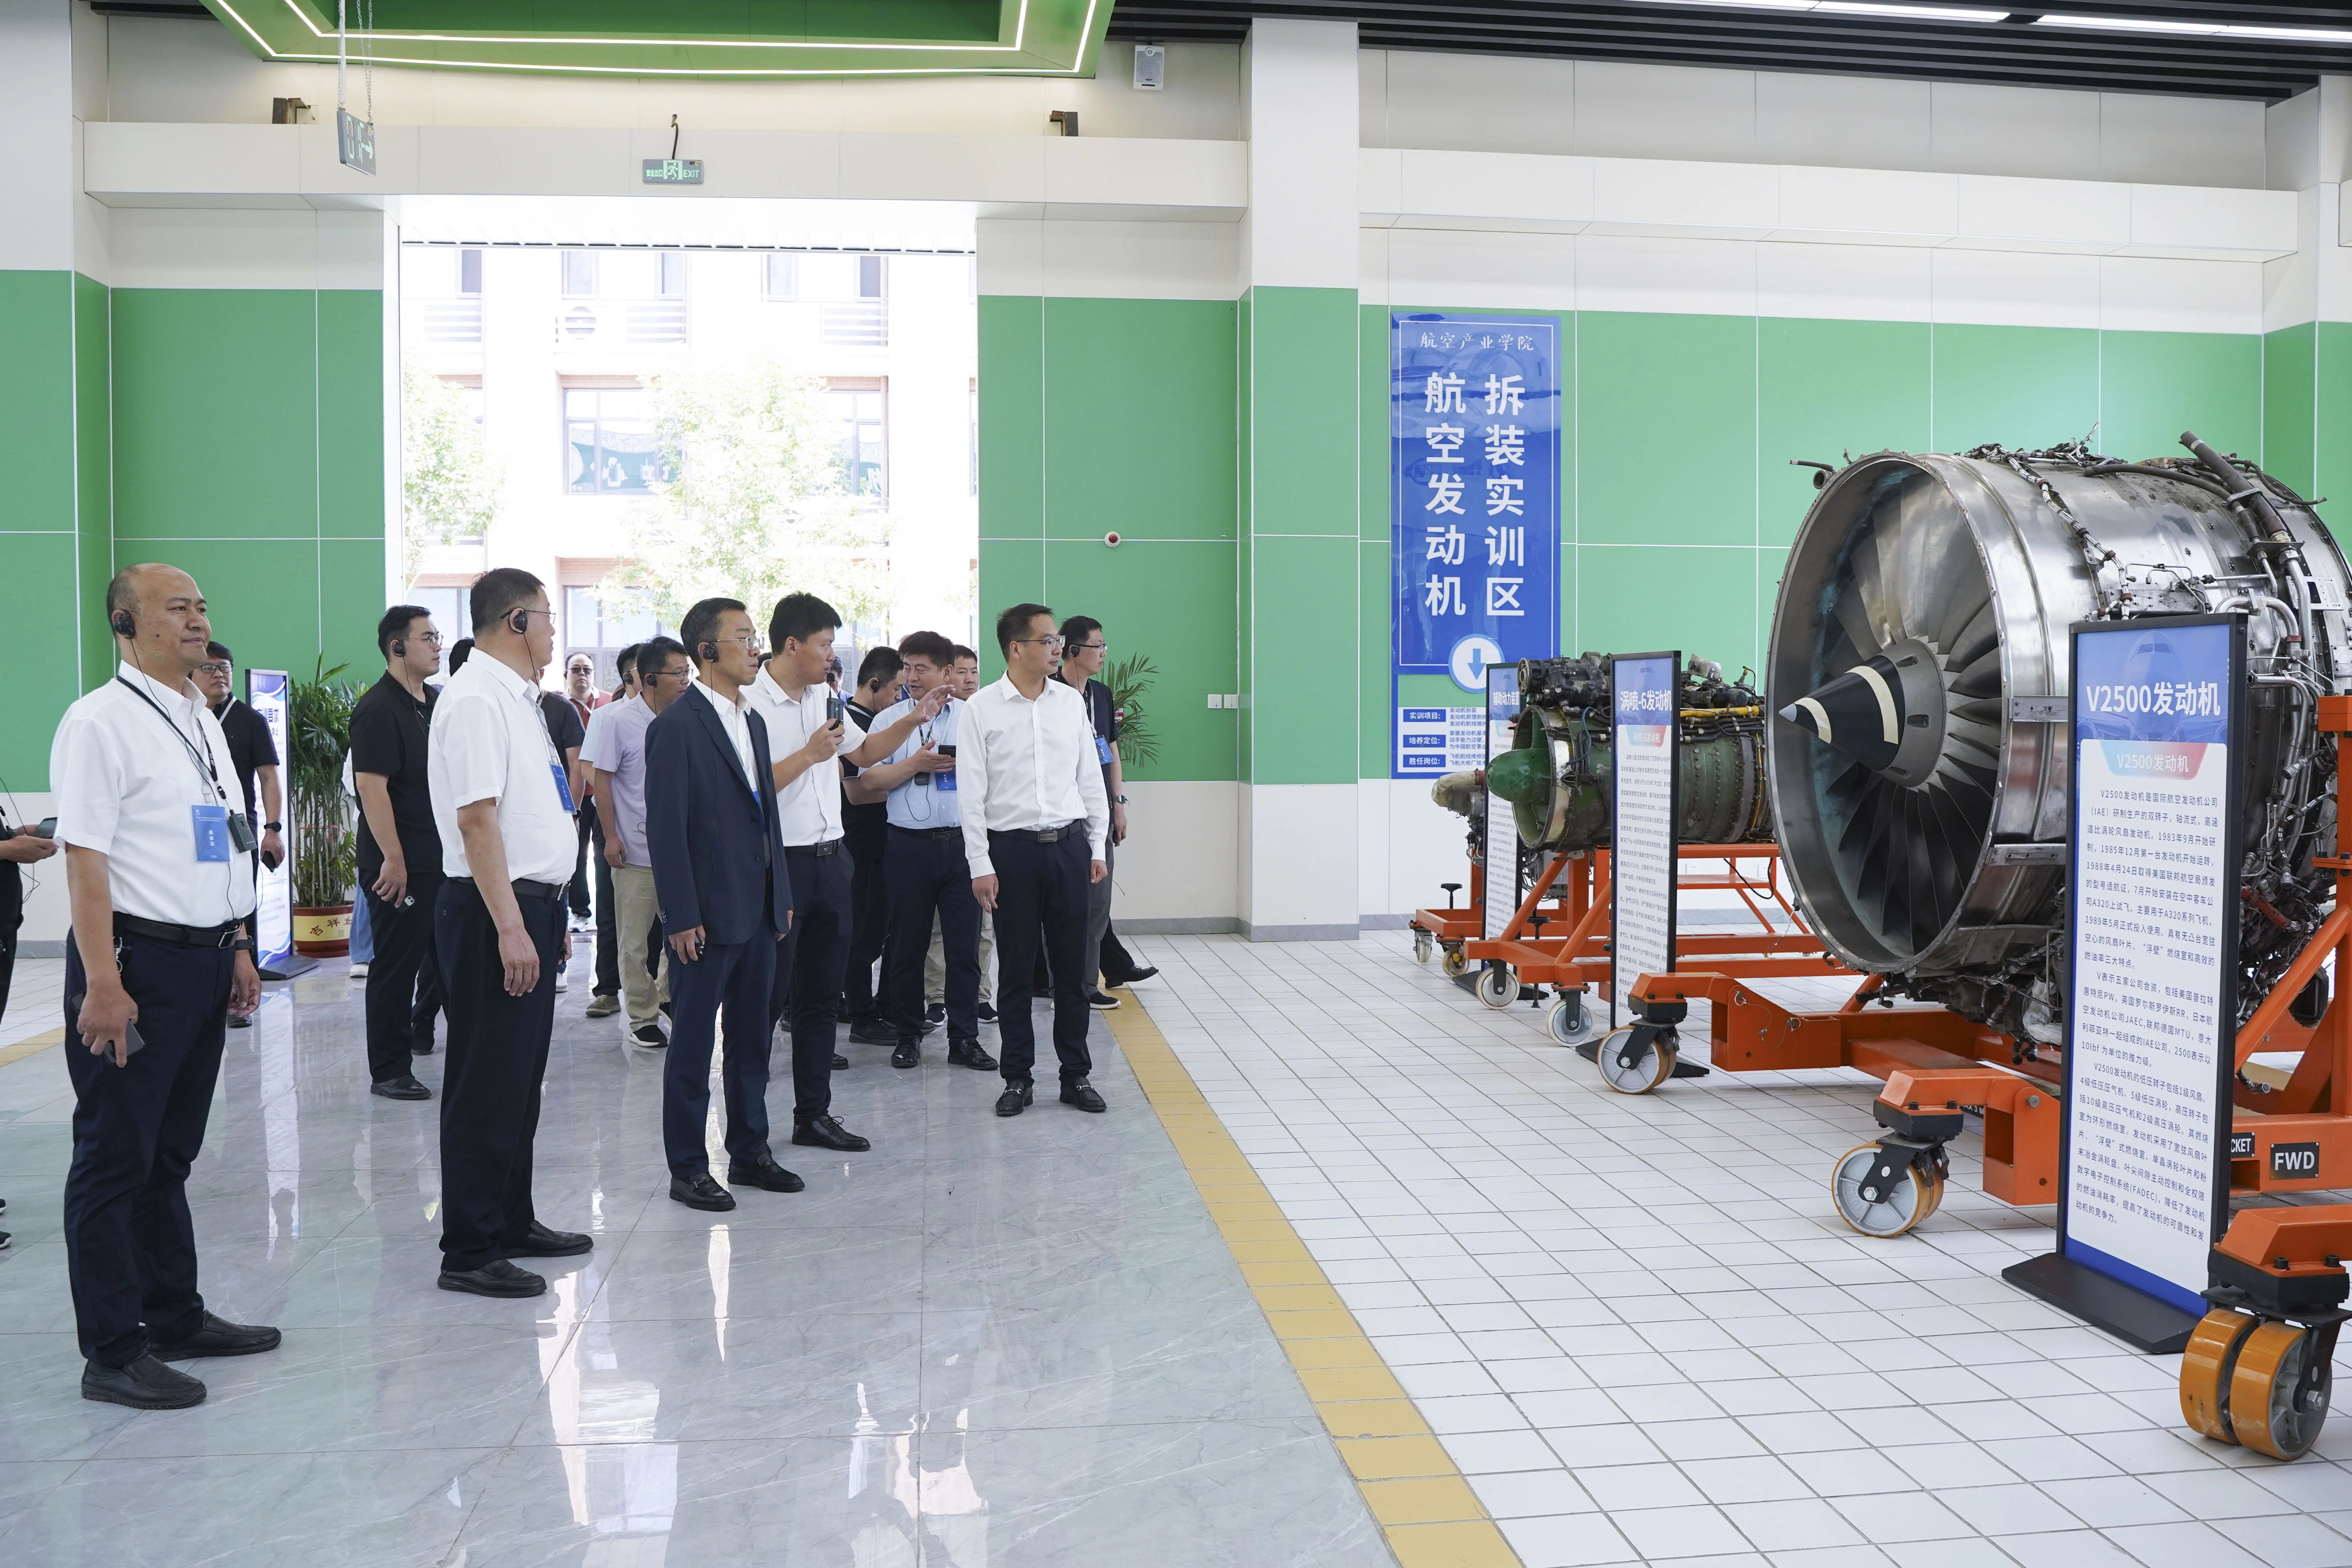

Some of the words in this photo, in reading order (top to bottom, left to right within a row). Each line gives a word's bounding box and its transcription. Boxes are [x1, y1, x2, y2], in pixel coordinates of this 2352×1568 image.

[1419, 332, 1534, 351] 航空产业学院
[1425, 372, 1466, 617] 航空发动机
[1485, 374, 1526, 617] 拆装实训区
[1493, 691, 1519, 706] 辅助动力装置
[1620, 690, 1672, 711] 涡喷-6发动机
[2086, 681, 2221, 716] V2500发动机
[2117, 754, 2189, 773] V2500发动机
[2100, 789, 2218, 807] V2500发动机是国际航空发动机公司
[2084, 951, 2135, 969] 燃油率三大特点。
[2102, 1045, 2152, 1067] 为单位的推力级。
[2275, 1151, 2314, 1171] FWD
[2076, 1200, 2117, 1224] 动机的竞争力。
